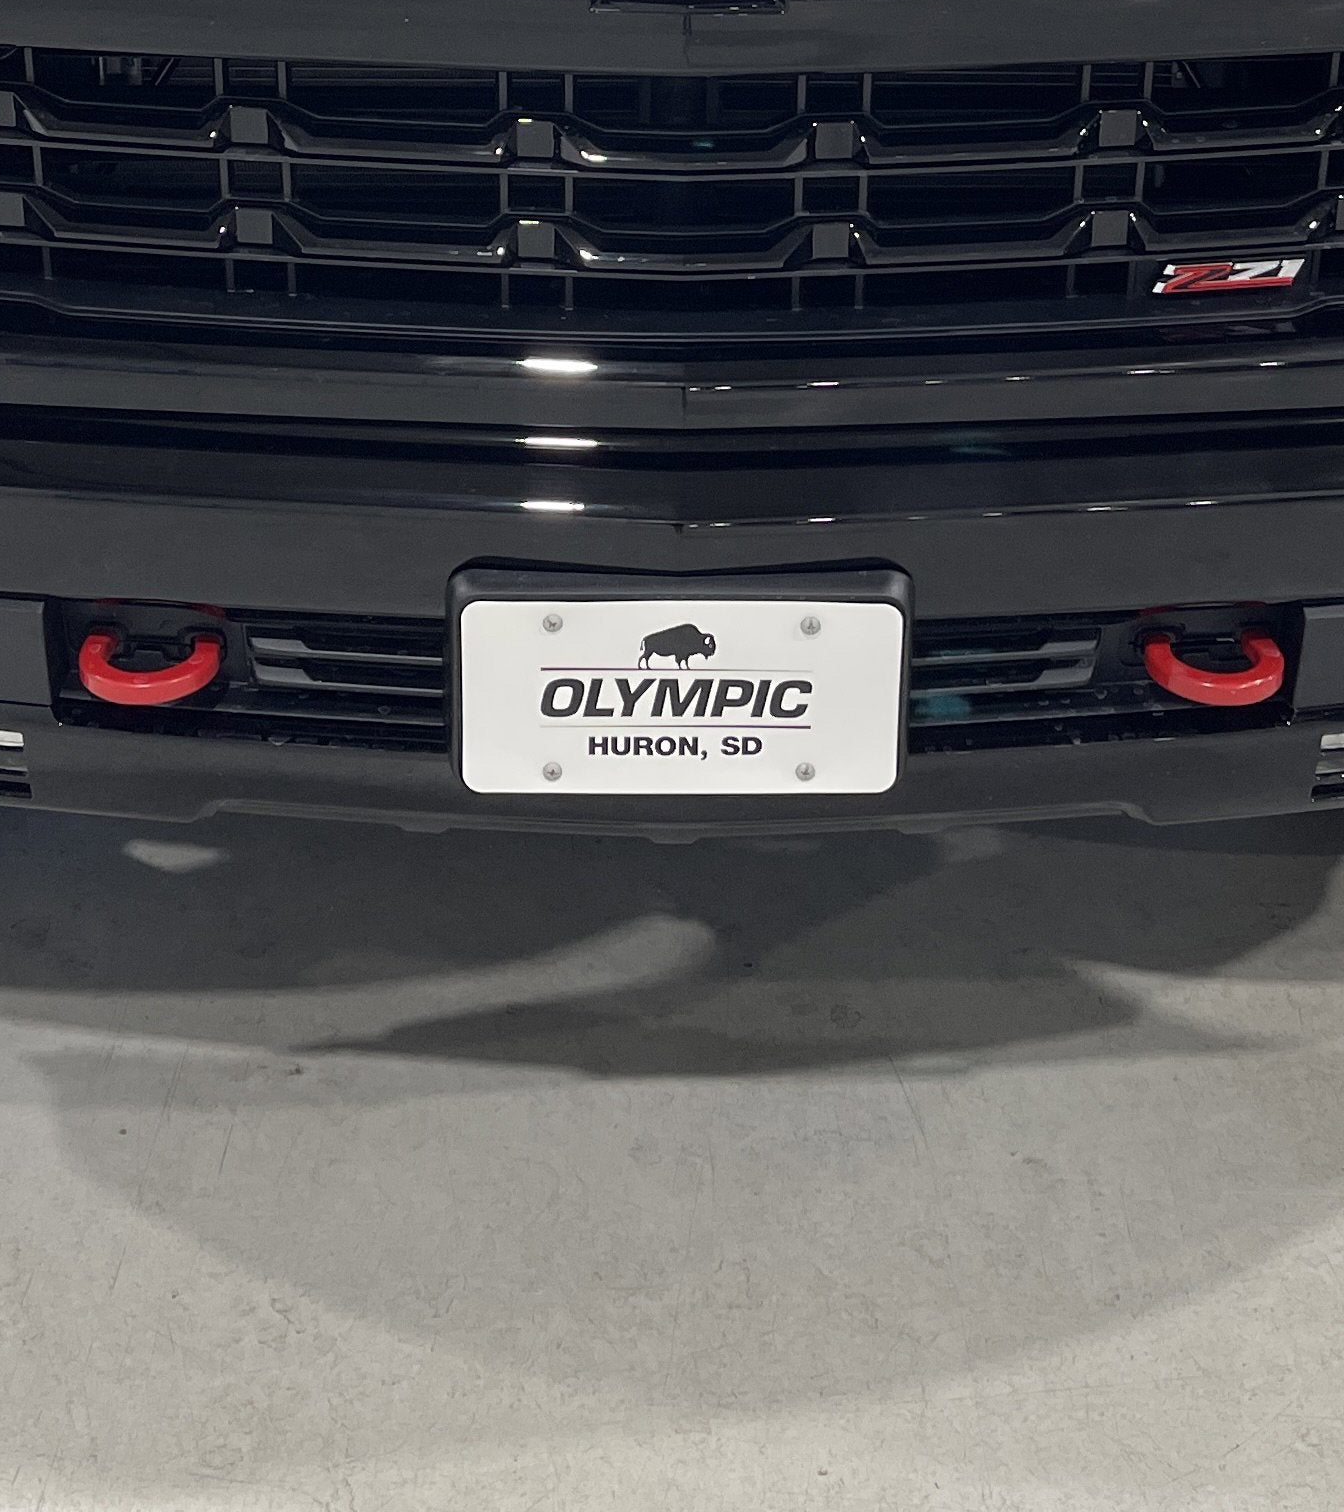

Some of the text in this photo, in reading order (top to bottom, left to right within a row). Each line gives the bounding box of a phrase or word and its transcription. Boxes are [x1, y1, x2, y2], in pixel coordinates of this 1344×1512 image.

[1152, 257, 1306, 294] Z71
[539, 677, 814, 719] OLYMPIC
[587, 736, 763, 760] HURON, SD
